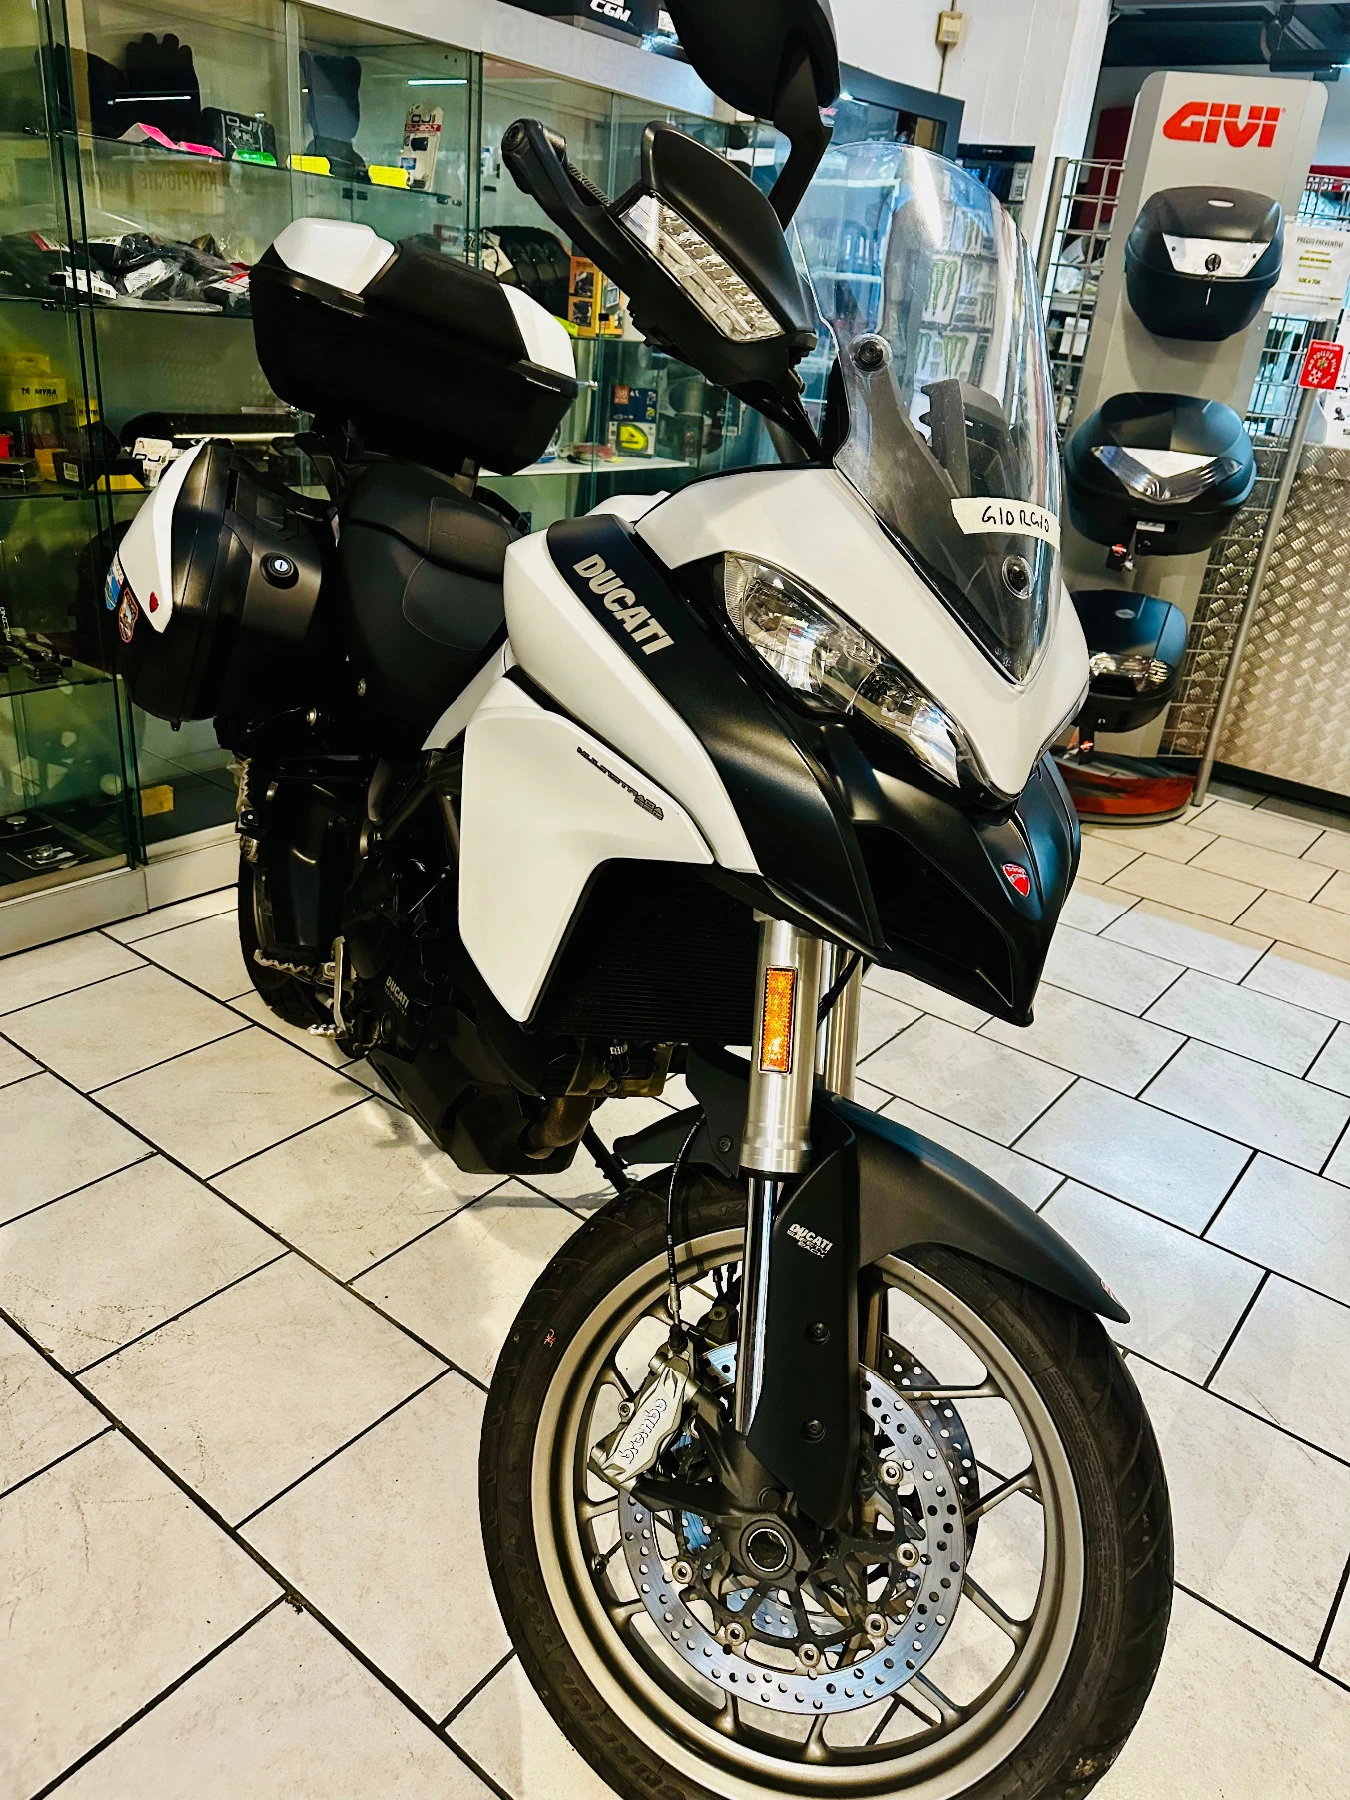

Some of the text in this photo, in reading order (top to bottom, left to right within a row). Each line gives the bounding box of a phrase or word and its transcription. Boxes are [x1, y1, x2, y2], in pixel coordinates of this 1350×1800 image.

[590, 0, 632, 22] CGM
[1162, 101, 1281, 148] GIVI
[982, 505, 1050, 532] GIORGIO
[572, 553, 675, 656] DUCATI
[386, 975, 410, 1009] DUCATI
[789, 1223, 834, 1251] DUCATI
[618, 1398, 668, 1465] brembo
